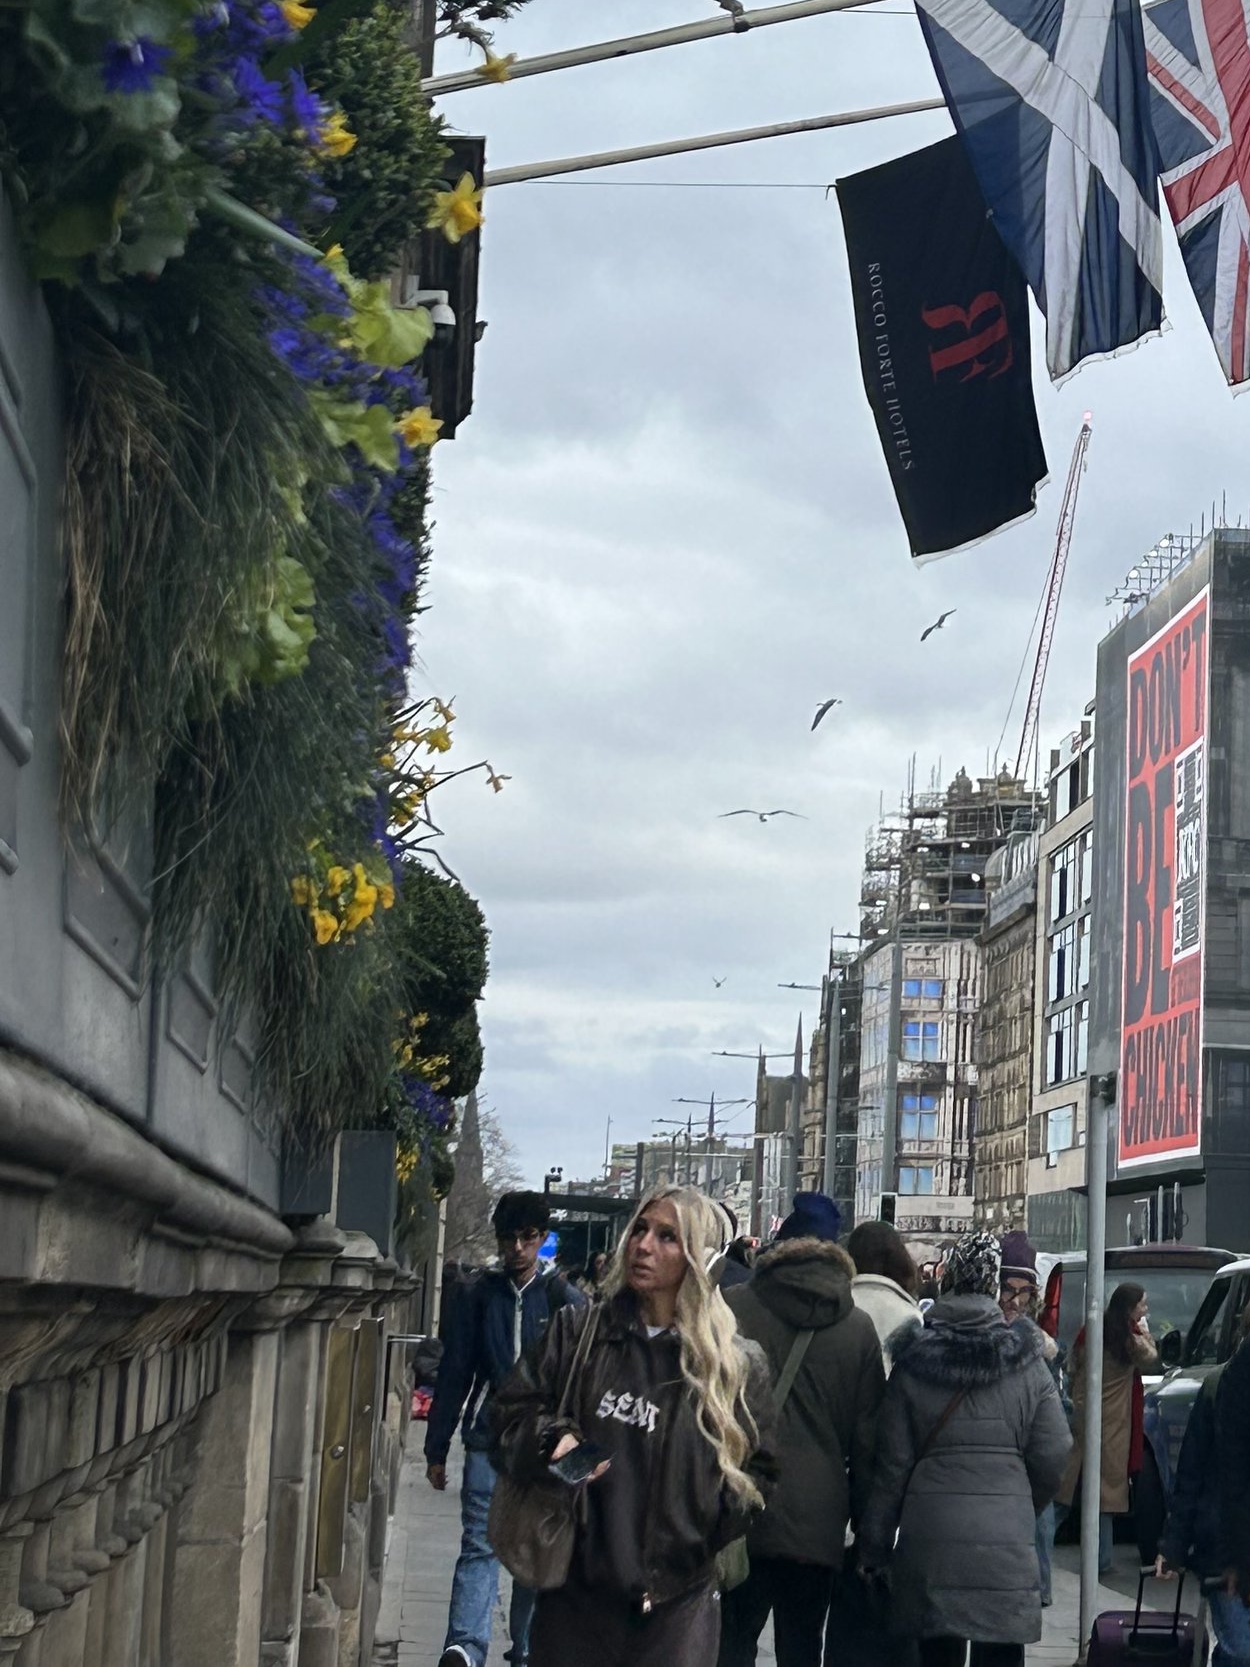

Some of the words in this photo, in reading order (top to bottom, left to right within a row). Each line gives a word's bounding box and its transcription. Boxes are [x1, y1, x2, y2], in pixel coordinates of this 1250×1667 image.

[868, 262, 887, 328] ROCCO
[875, 334, 896, 392] FORTE
[886, 398, 913, 471] HOTELS
[1130, 610, 1206, 781] DON'T
[1124, 1008, 1200, 1148] CHICKEN
